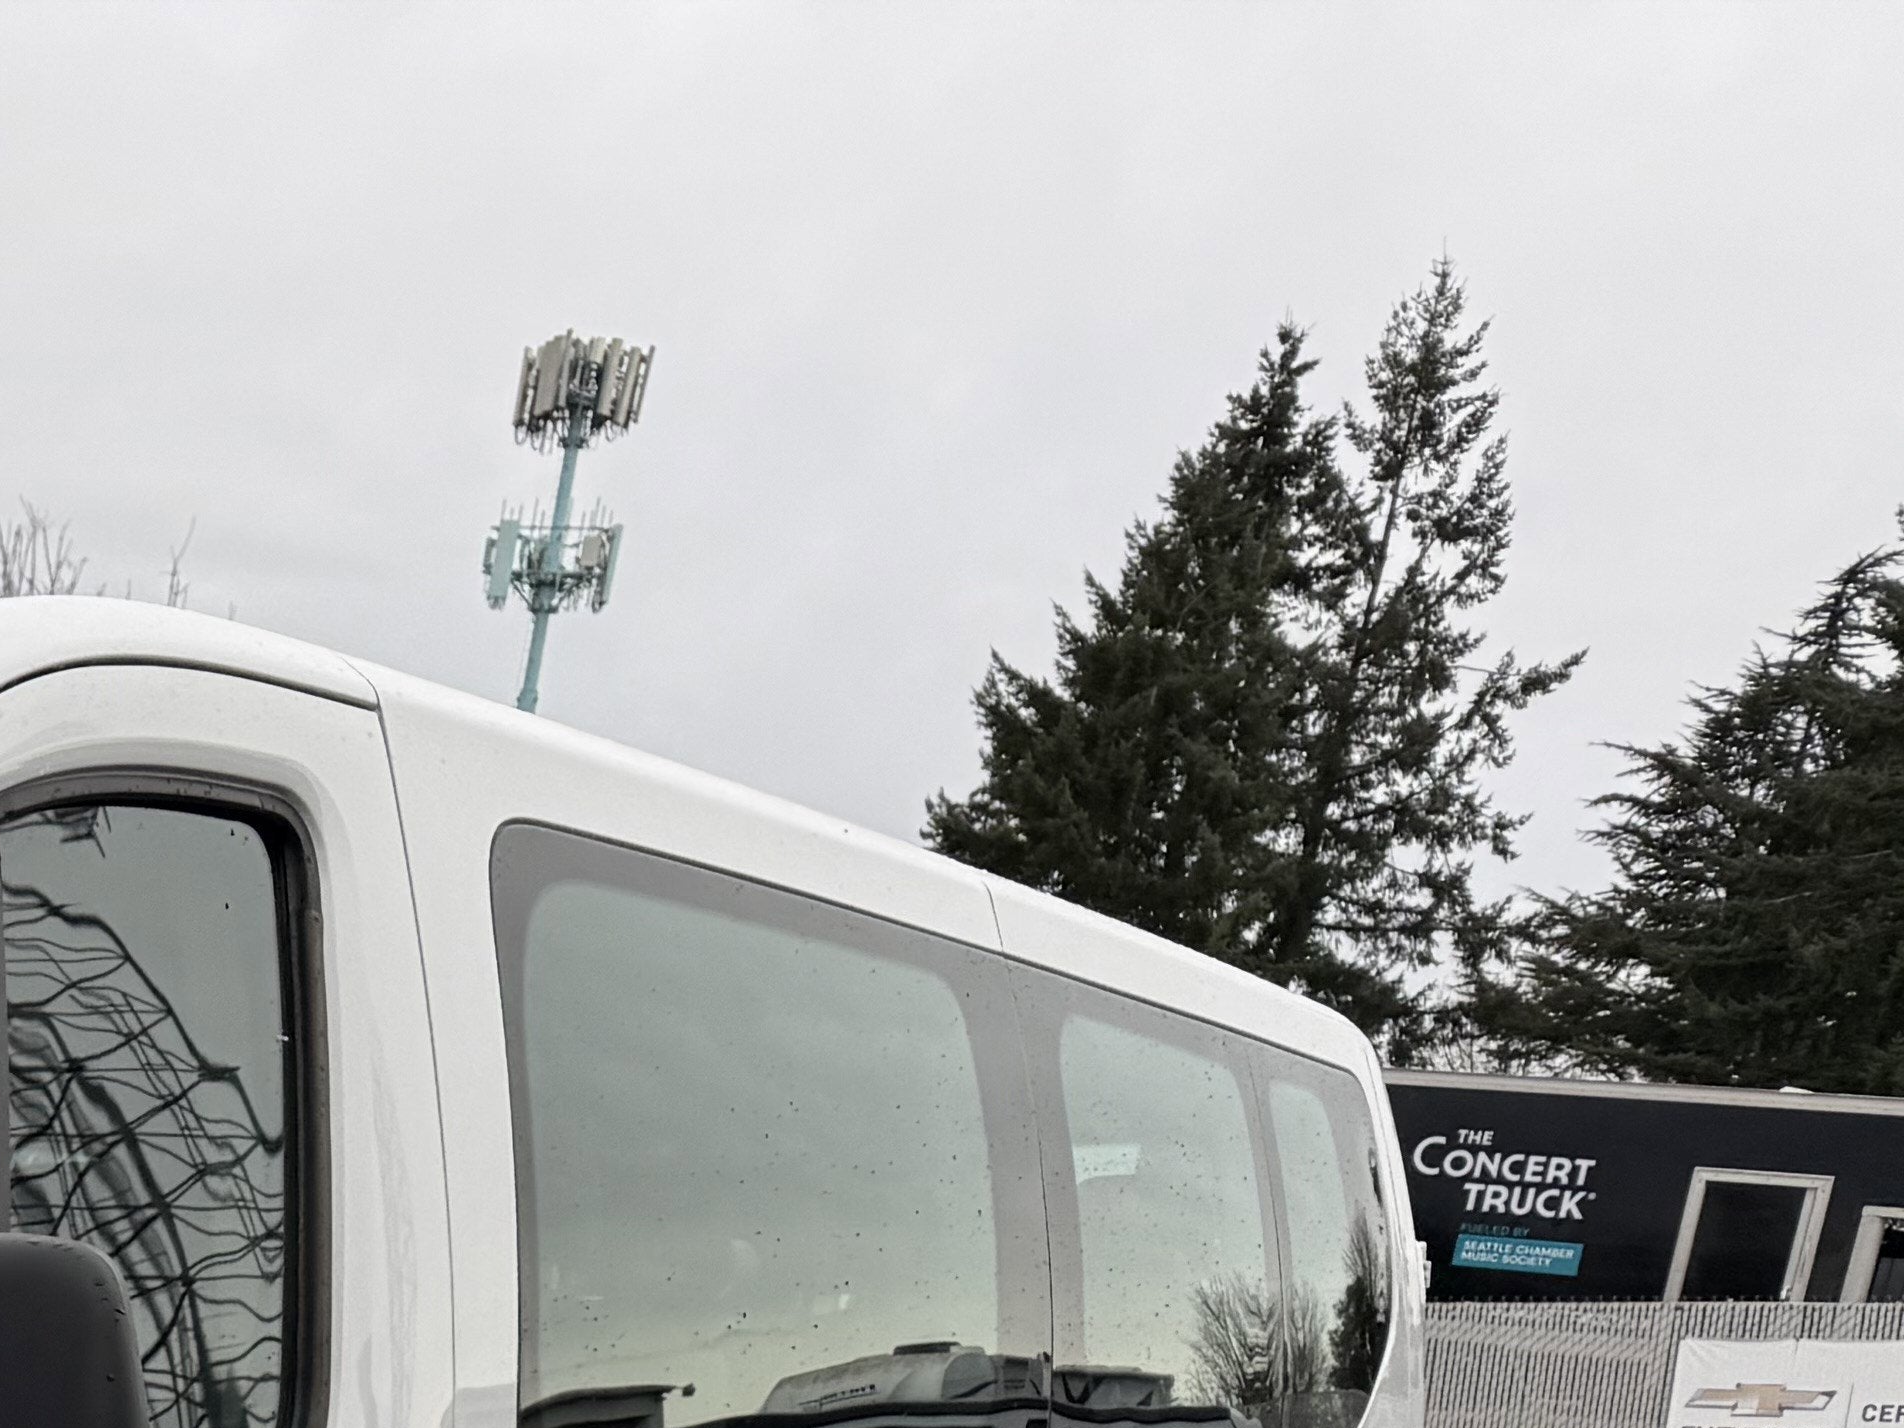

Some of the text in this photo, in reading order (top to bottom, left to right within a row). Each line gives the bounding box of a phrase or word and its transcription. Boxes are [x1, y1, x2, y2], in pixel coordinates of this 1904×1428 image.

[1457, 1129, 1494, 1146] THE
[1413, 1135, 1597, 1186] CONCERT
[1463, 1182, 1588, 1220] TRUCK
[1512, 1225, 1530, 1237] BY
[1461, 1250, 1553, 1267] MUSIC SOCIETY
[1463, 1240, 1575, 1259] SEATTLE CHAMBER
